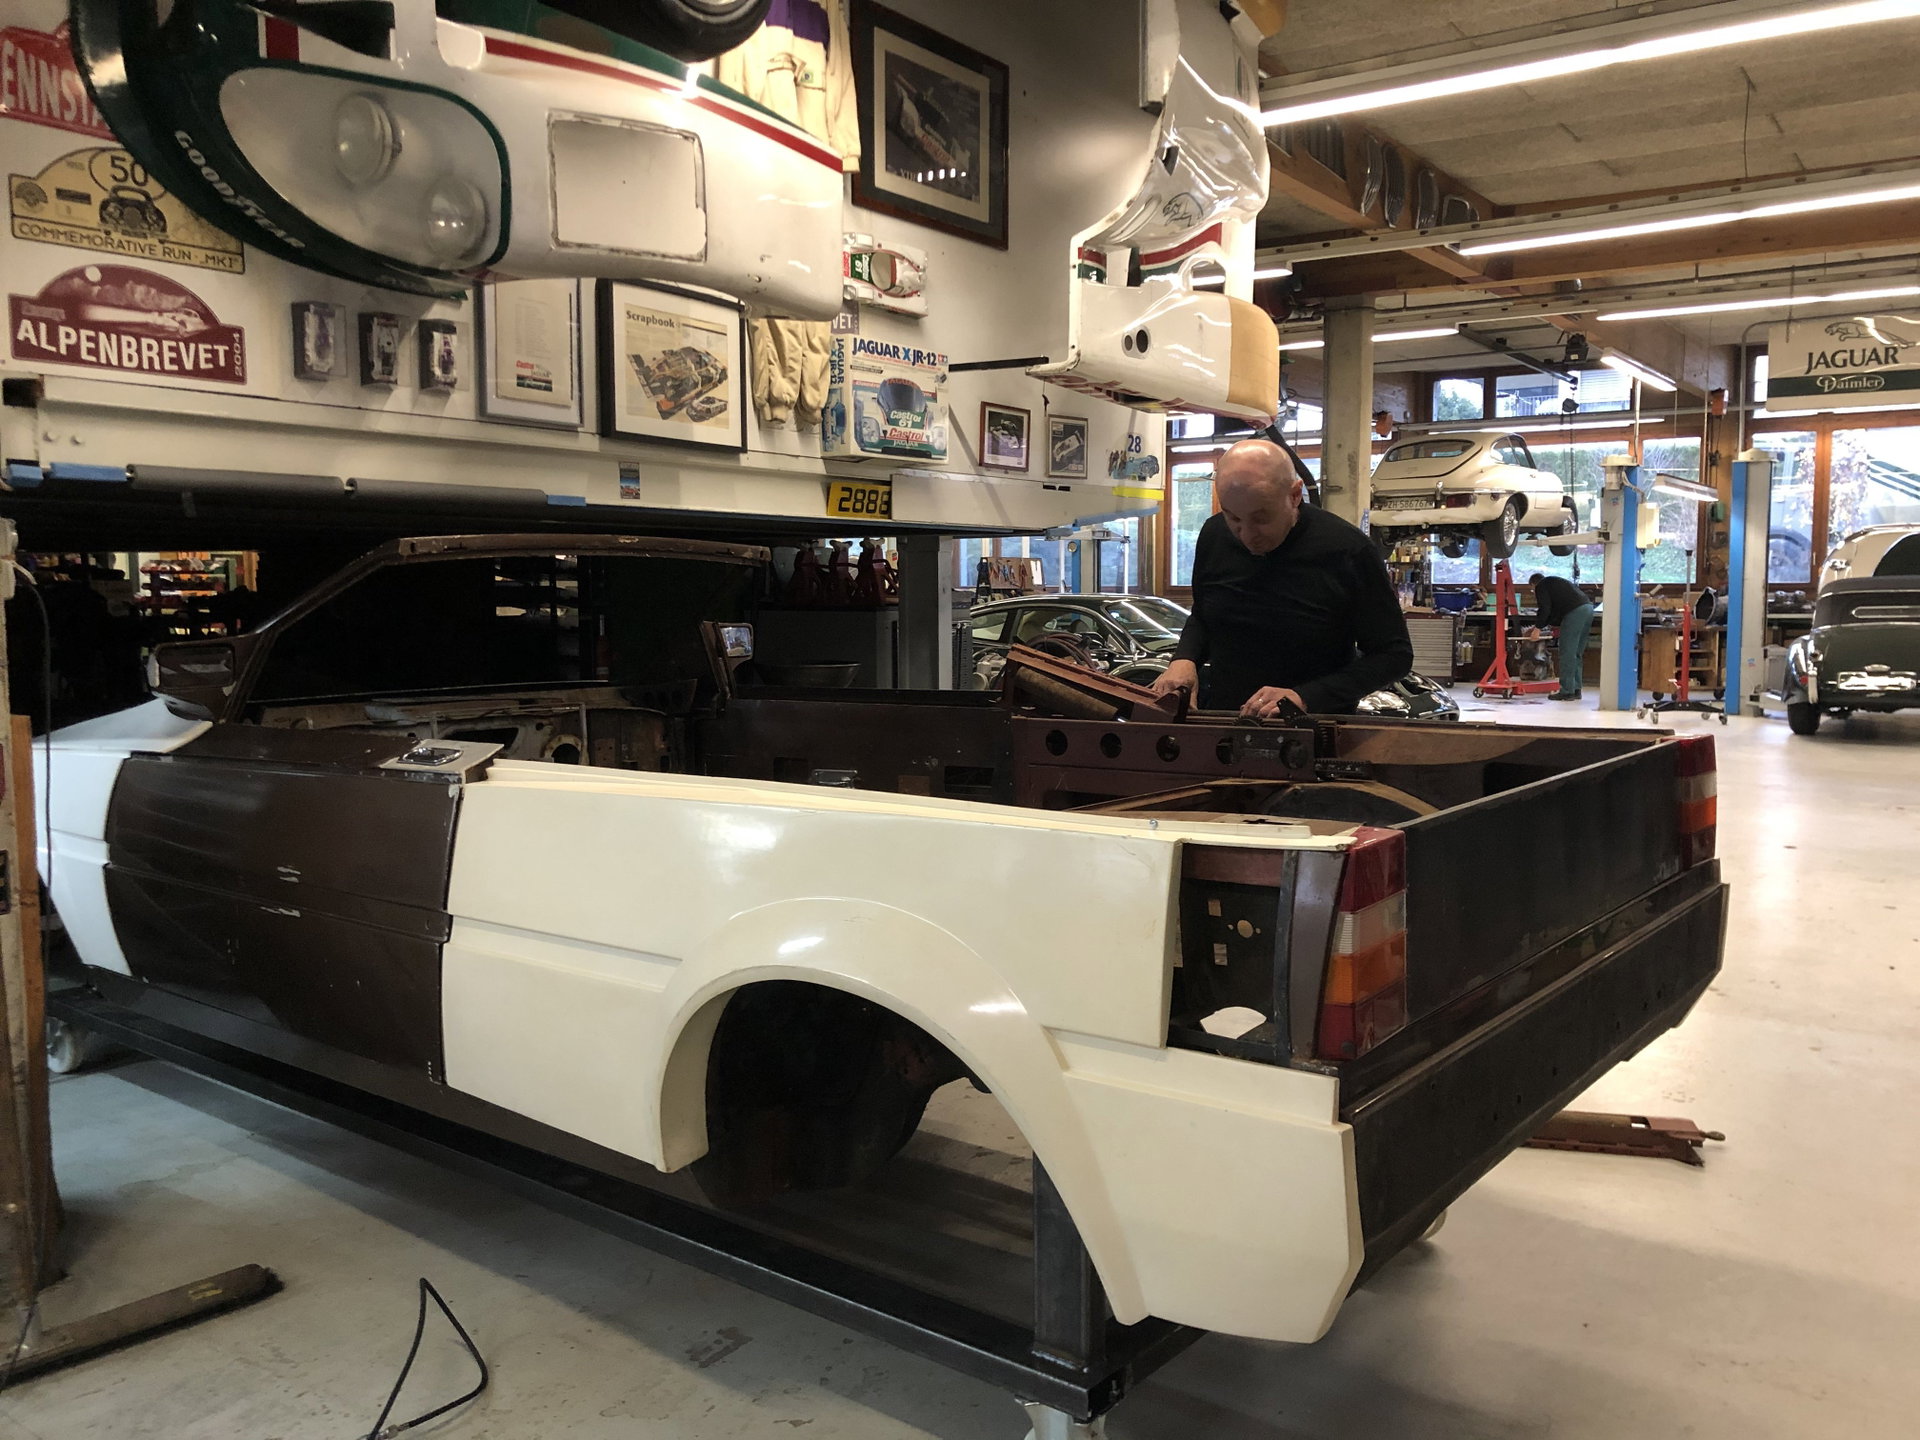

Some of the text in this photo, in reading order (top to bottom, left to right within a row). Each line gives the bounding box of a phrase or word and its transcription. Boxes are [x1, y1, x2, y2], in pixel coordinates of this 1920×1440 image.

[111, 155, 149, 186] 50
[18, 222, 158, 256] COMMEMORATIVE
[162, 247, 193, 261] RUN
[625, 309, 676, 329] Scrapbook
[16, 318, 230, 371] ALPENBREVET
[233, 331, 242, 377] 2004
[852, 337, 901, 360] JAGUAR
[836, 338, 845, 385] JAGUAR
[1805, 346, 1900, 375] JAGUAR
[1816, 375, 1883, 393] Daimler
[890, 409, 922, 424] Castrol
[888, 427, 925, 441] Castrol
[1127, 434, 1142, 454] 28
